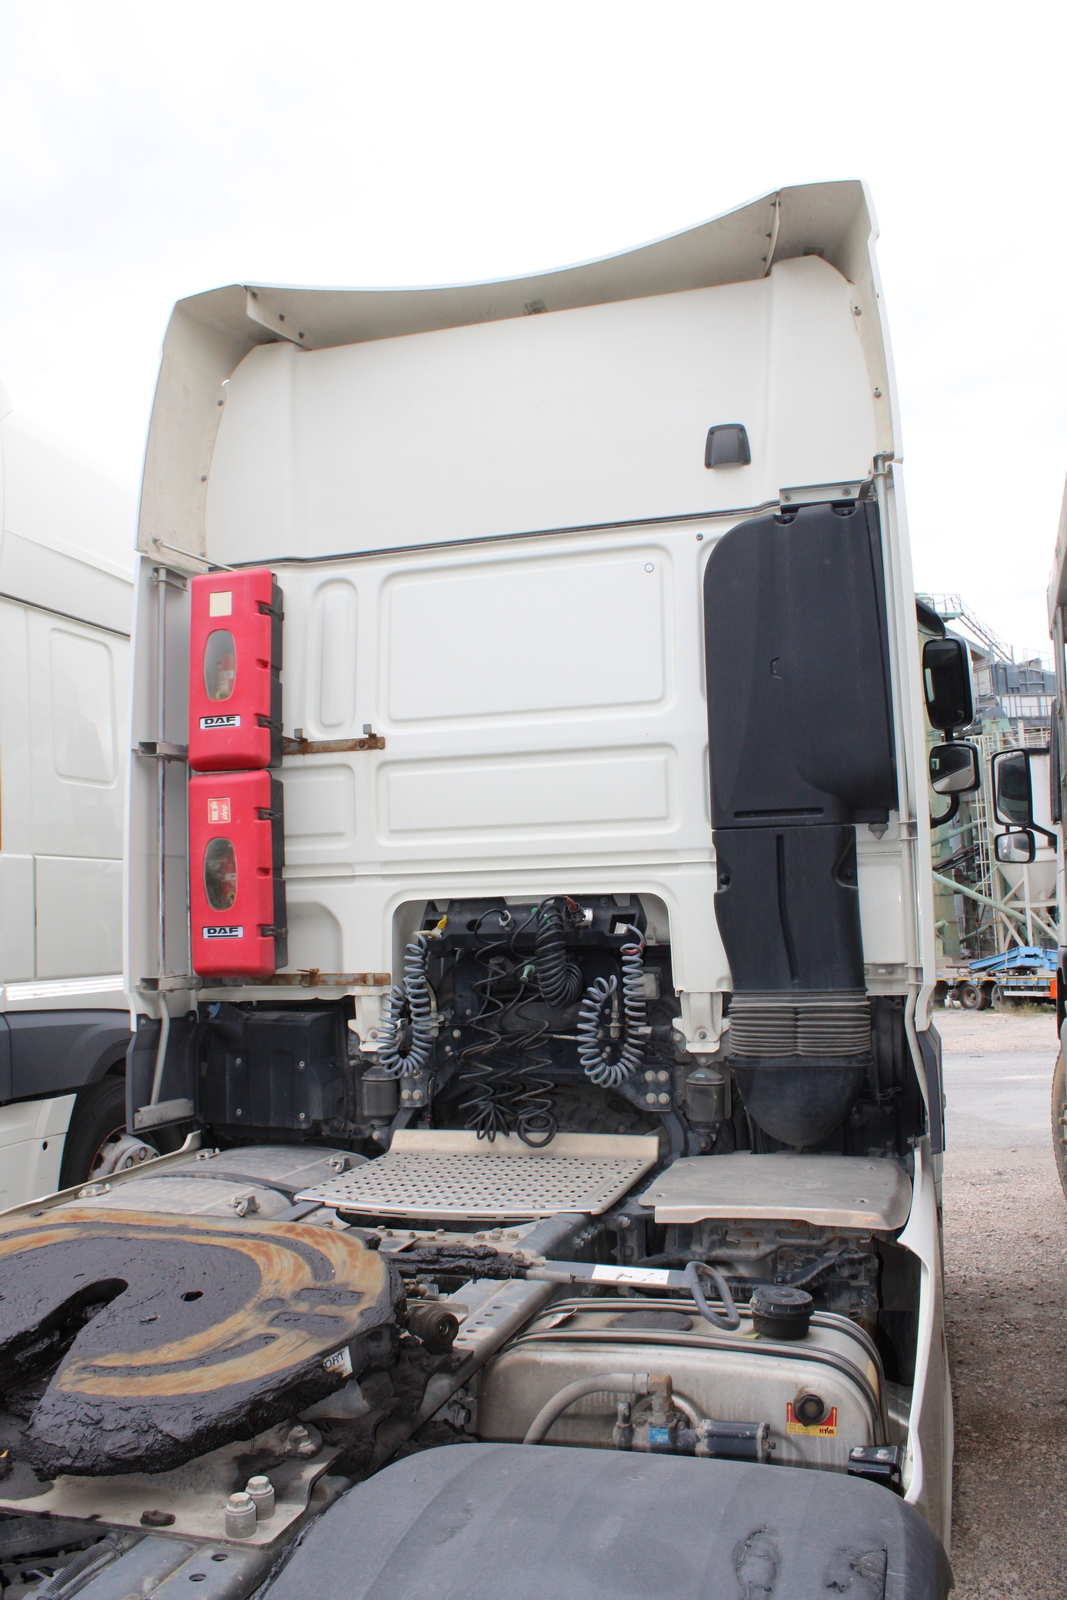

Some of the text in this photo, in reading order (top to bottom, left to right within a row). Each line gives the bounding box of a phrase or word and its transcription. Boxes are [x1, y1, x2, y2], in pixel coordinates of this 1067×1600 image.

[204, 716, 236, 725] DAF
[207, 927, 239, 935] DAF
[819, 1427, 835, 1435] HYVA
